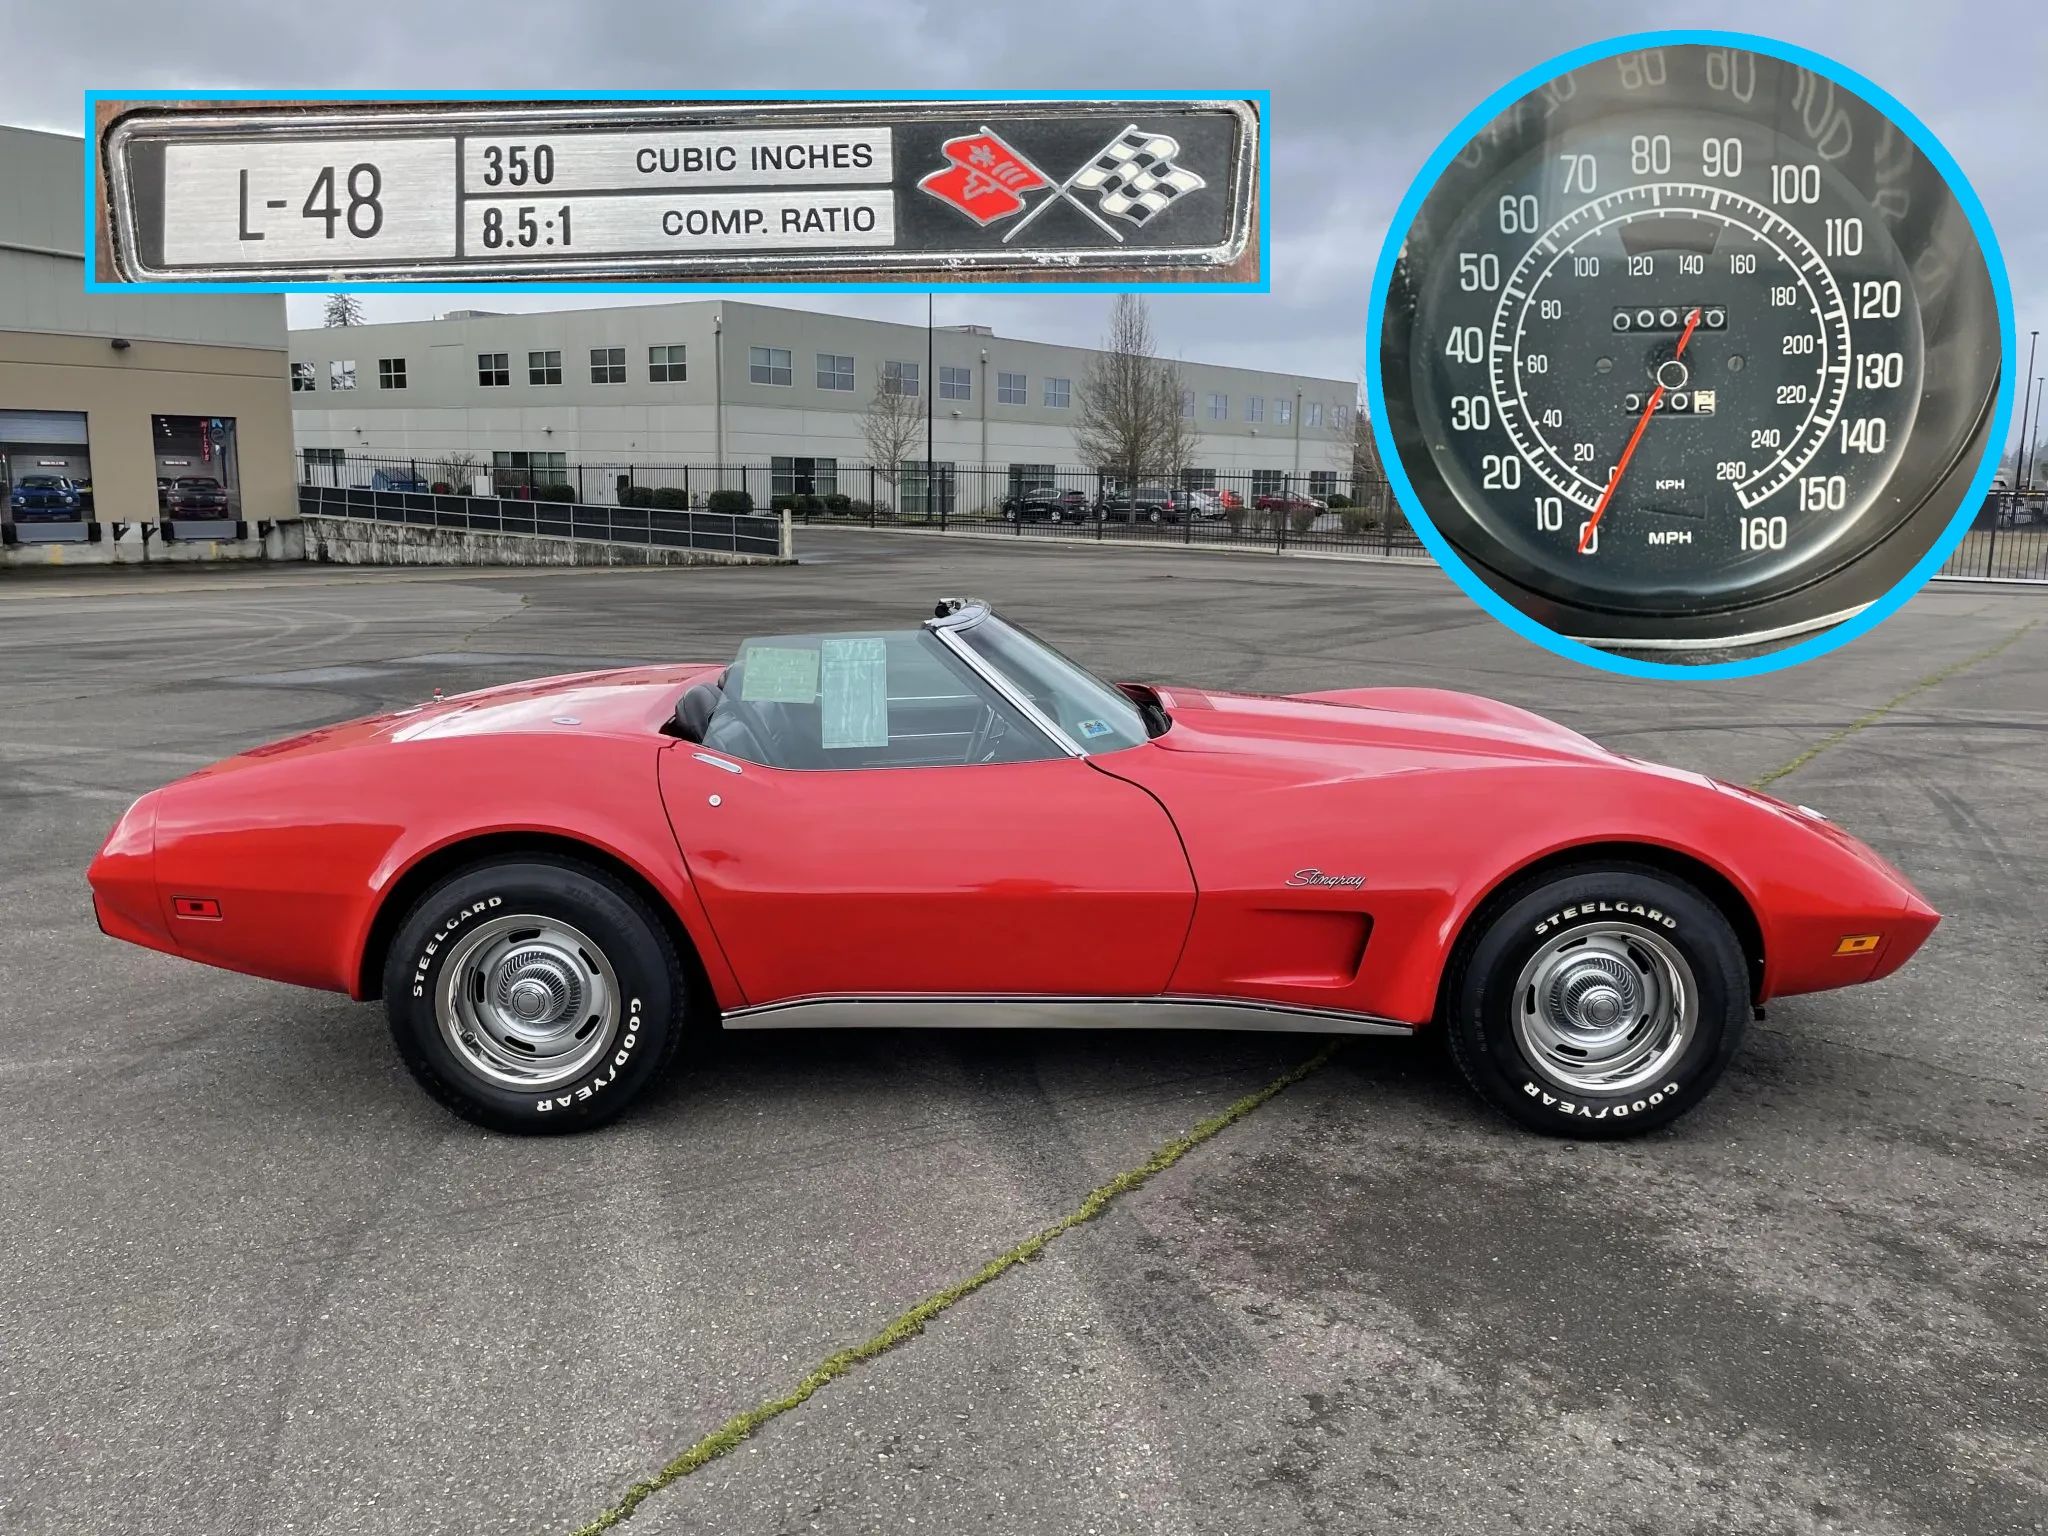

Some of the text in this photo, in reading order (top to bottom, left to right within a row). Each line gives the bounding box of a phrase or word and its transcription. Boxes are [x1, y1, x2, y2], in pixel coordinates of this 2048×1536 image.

[484, 144, 872, 186] 350 CUBIC INCHES
[1632, 135, 1670, 174] 80
[1703, 138, 1741, 177] 90
[1561, 155, 1596, 193] 70
[1771, 165, 1820, 204] 100
[239, 163, 383, 240] L-48
[1500, 195, 1538, 233] 60
[483, 206, 875, 248] 8.5:1 COMP. RATIO
[1826, 218, 1862, 256] 110
[1460, 253, 1499, 291] 50
[1574, 257, 1599, 276] 100
[1628, 256, 1653, 275] 120
[1680, 255, 1703, 274] 140
[1731, 255, 1755, 274] 160
[1541, 300, 1561, 319] 80
[1771, 287, 1796, 306] 180
[1853, 281, 1901, 319] 120
[1446, 326, 1483, 363] 40
[1783, 335, 1813, 354] 200
[1528, 355, 1547, 373] 60
[1857, 353, 1903, 389] 130
[1777, 385, 1806, 404] 220
[1452, 396, 1490, 430] 30
[1543, 409, 1562, 427] 40
[1574, 443, 1594, 461] 20
[1752, 429, 1780, 448] 240
[1841, 418, 1885, 454] 140
[1483, 455, 1521, 489] 20
[1656, 479, 1684, 489] KPH
[1717, 462, 1746, 480] 260
[1800, 476, 1845, 511] 150
[1535, 497, 1562, 530] 10
[1580, 521, 1598, 554] 0
[1649, 532, 1691, 544] MPH
[1740, 517, 1787, 550] 160
[1285, 868, 1366, 889] Stingray
[1534, 901, 1677, 935] STEELGARD
[413, 897, 502, 997] STEELGARD
[537, 999, 642, 1112] GOODYEAR
[1523, 1082, 1679, 1119] GOODYEAR
